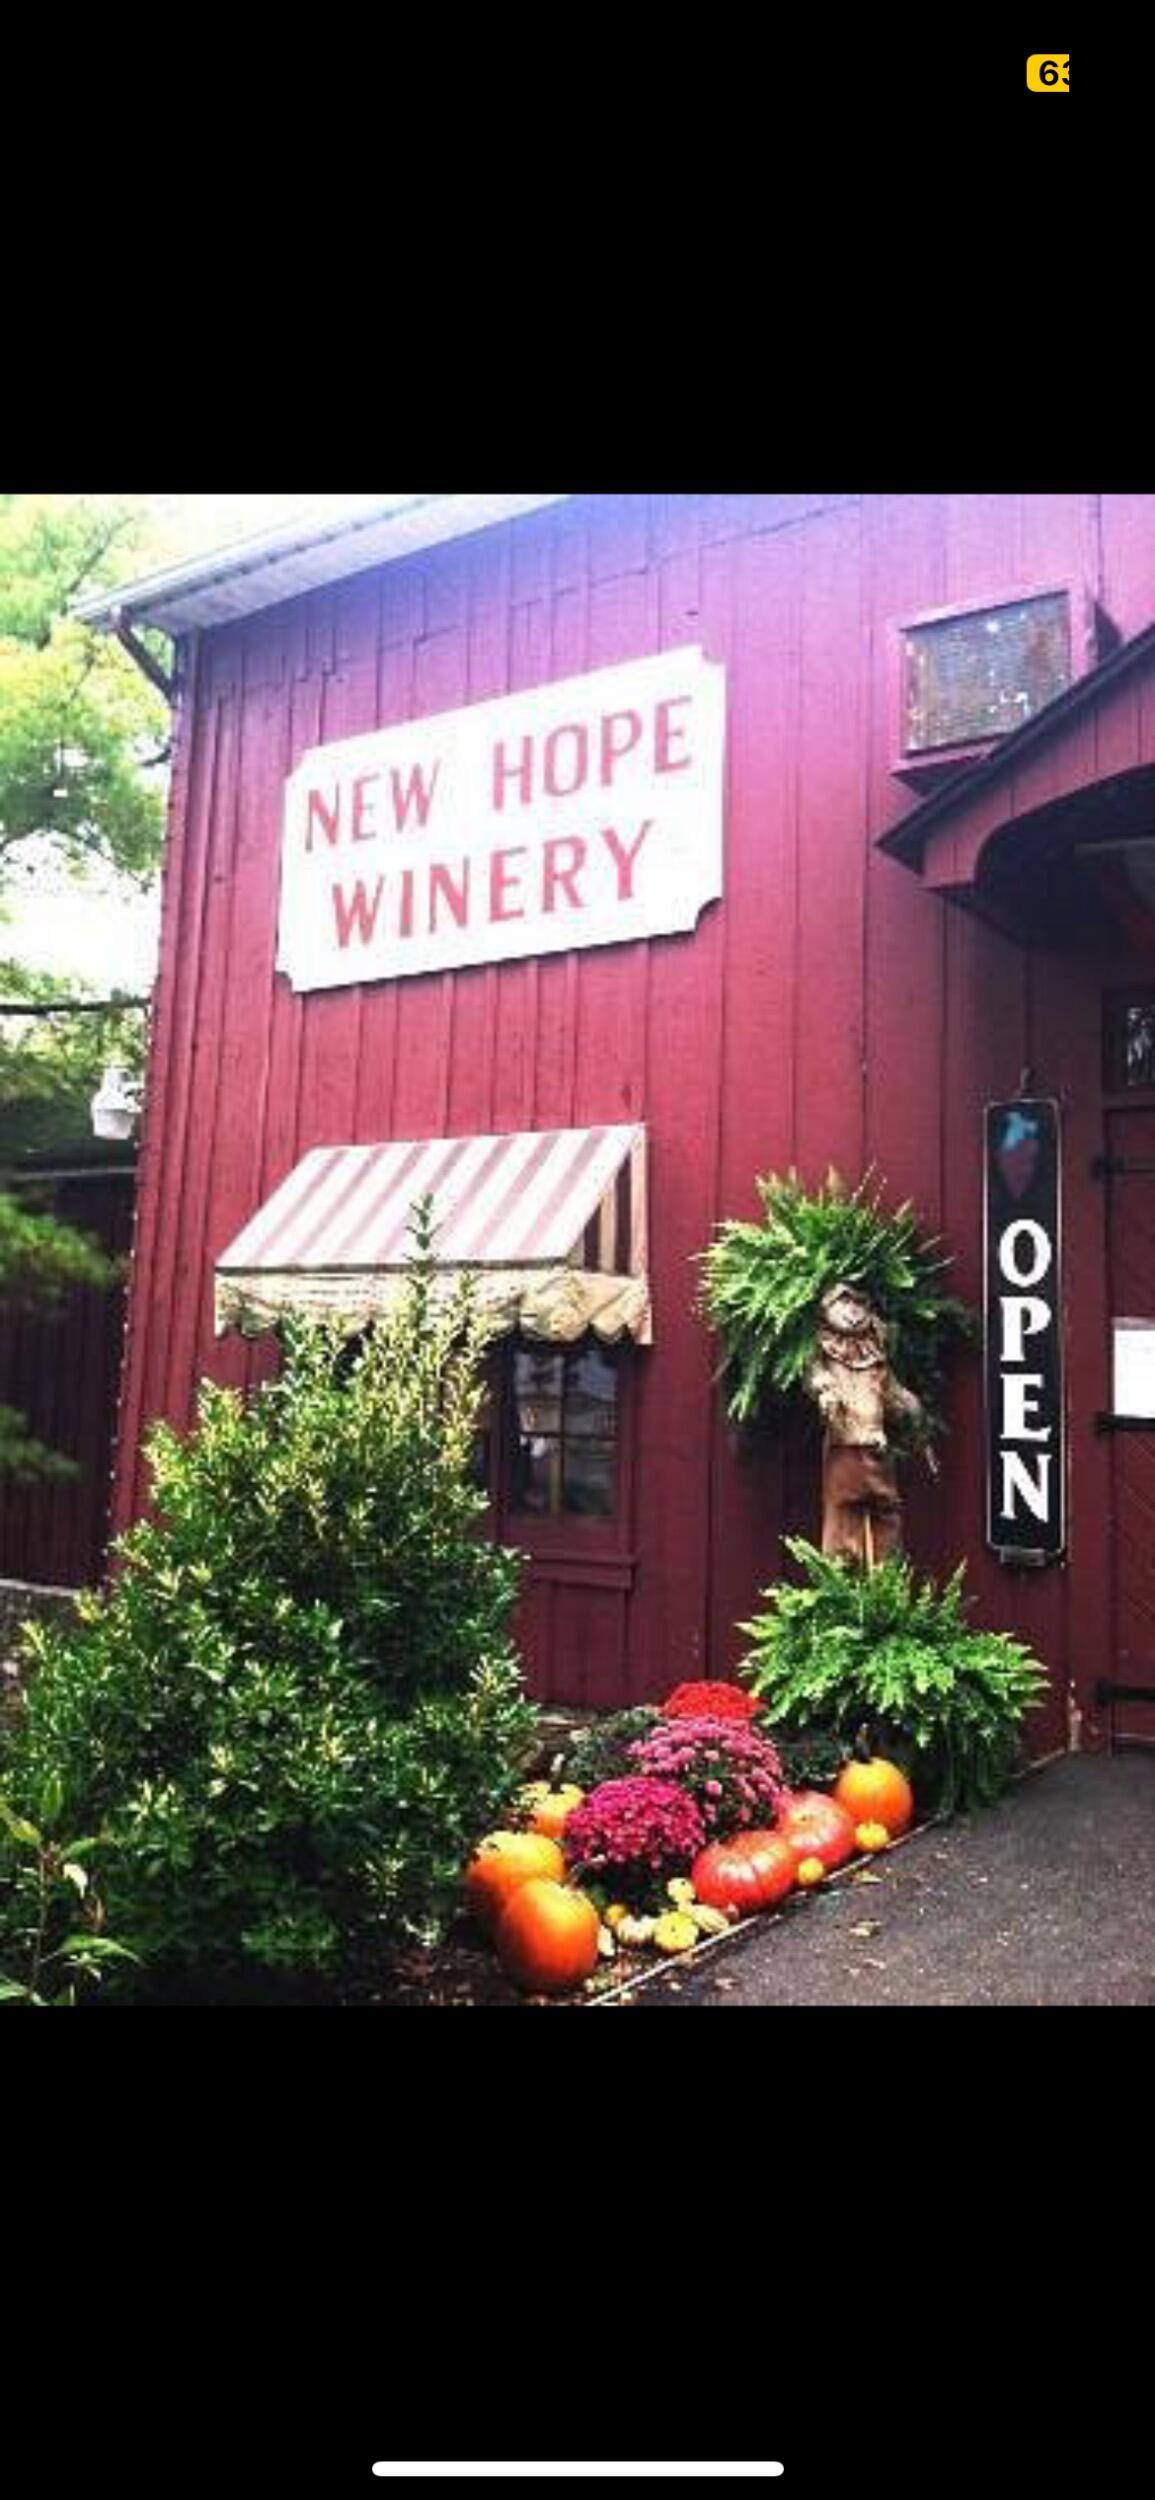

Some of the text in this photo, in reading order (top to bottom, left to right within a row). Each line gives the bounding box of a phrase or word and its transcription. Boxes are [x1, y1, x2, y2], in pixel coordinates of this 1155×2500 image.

[306, 696, 692, 853] NEW HOPE
[332, 819, 653, 949] WINERY
[999, 1219, 1052, 1523] OPEN
